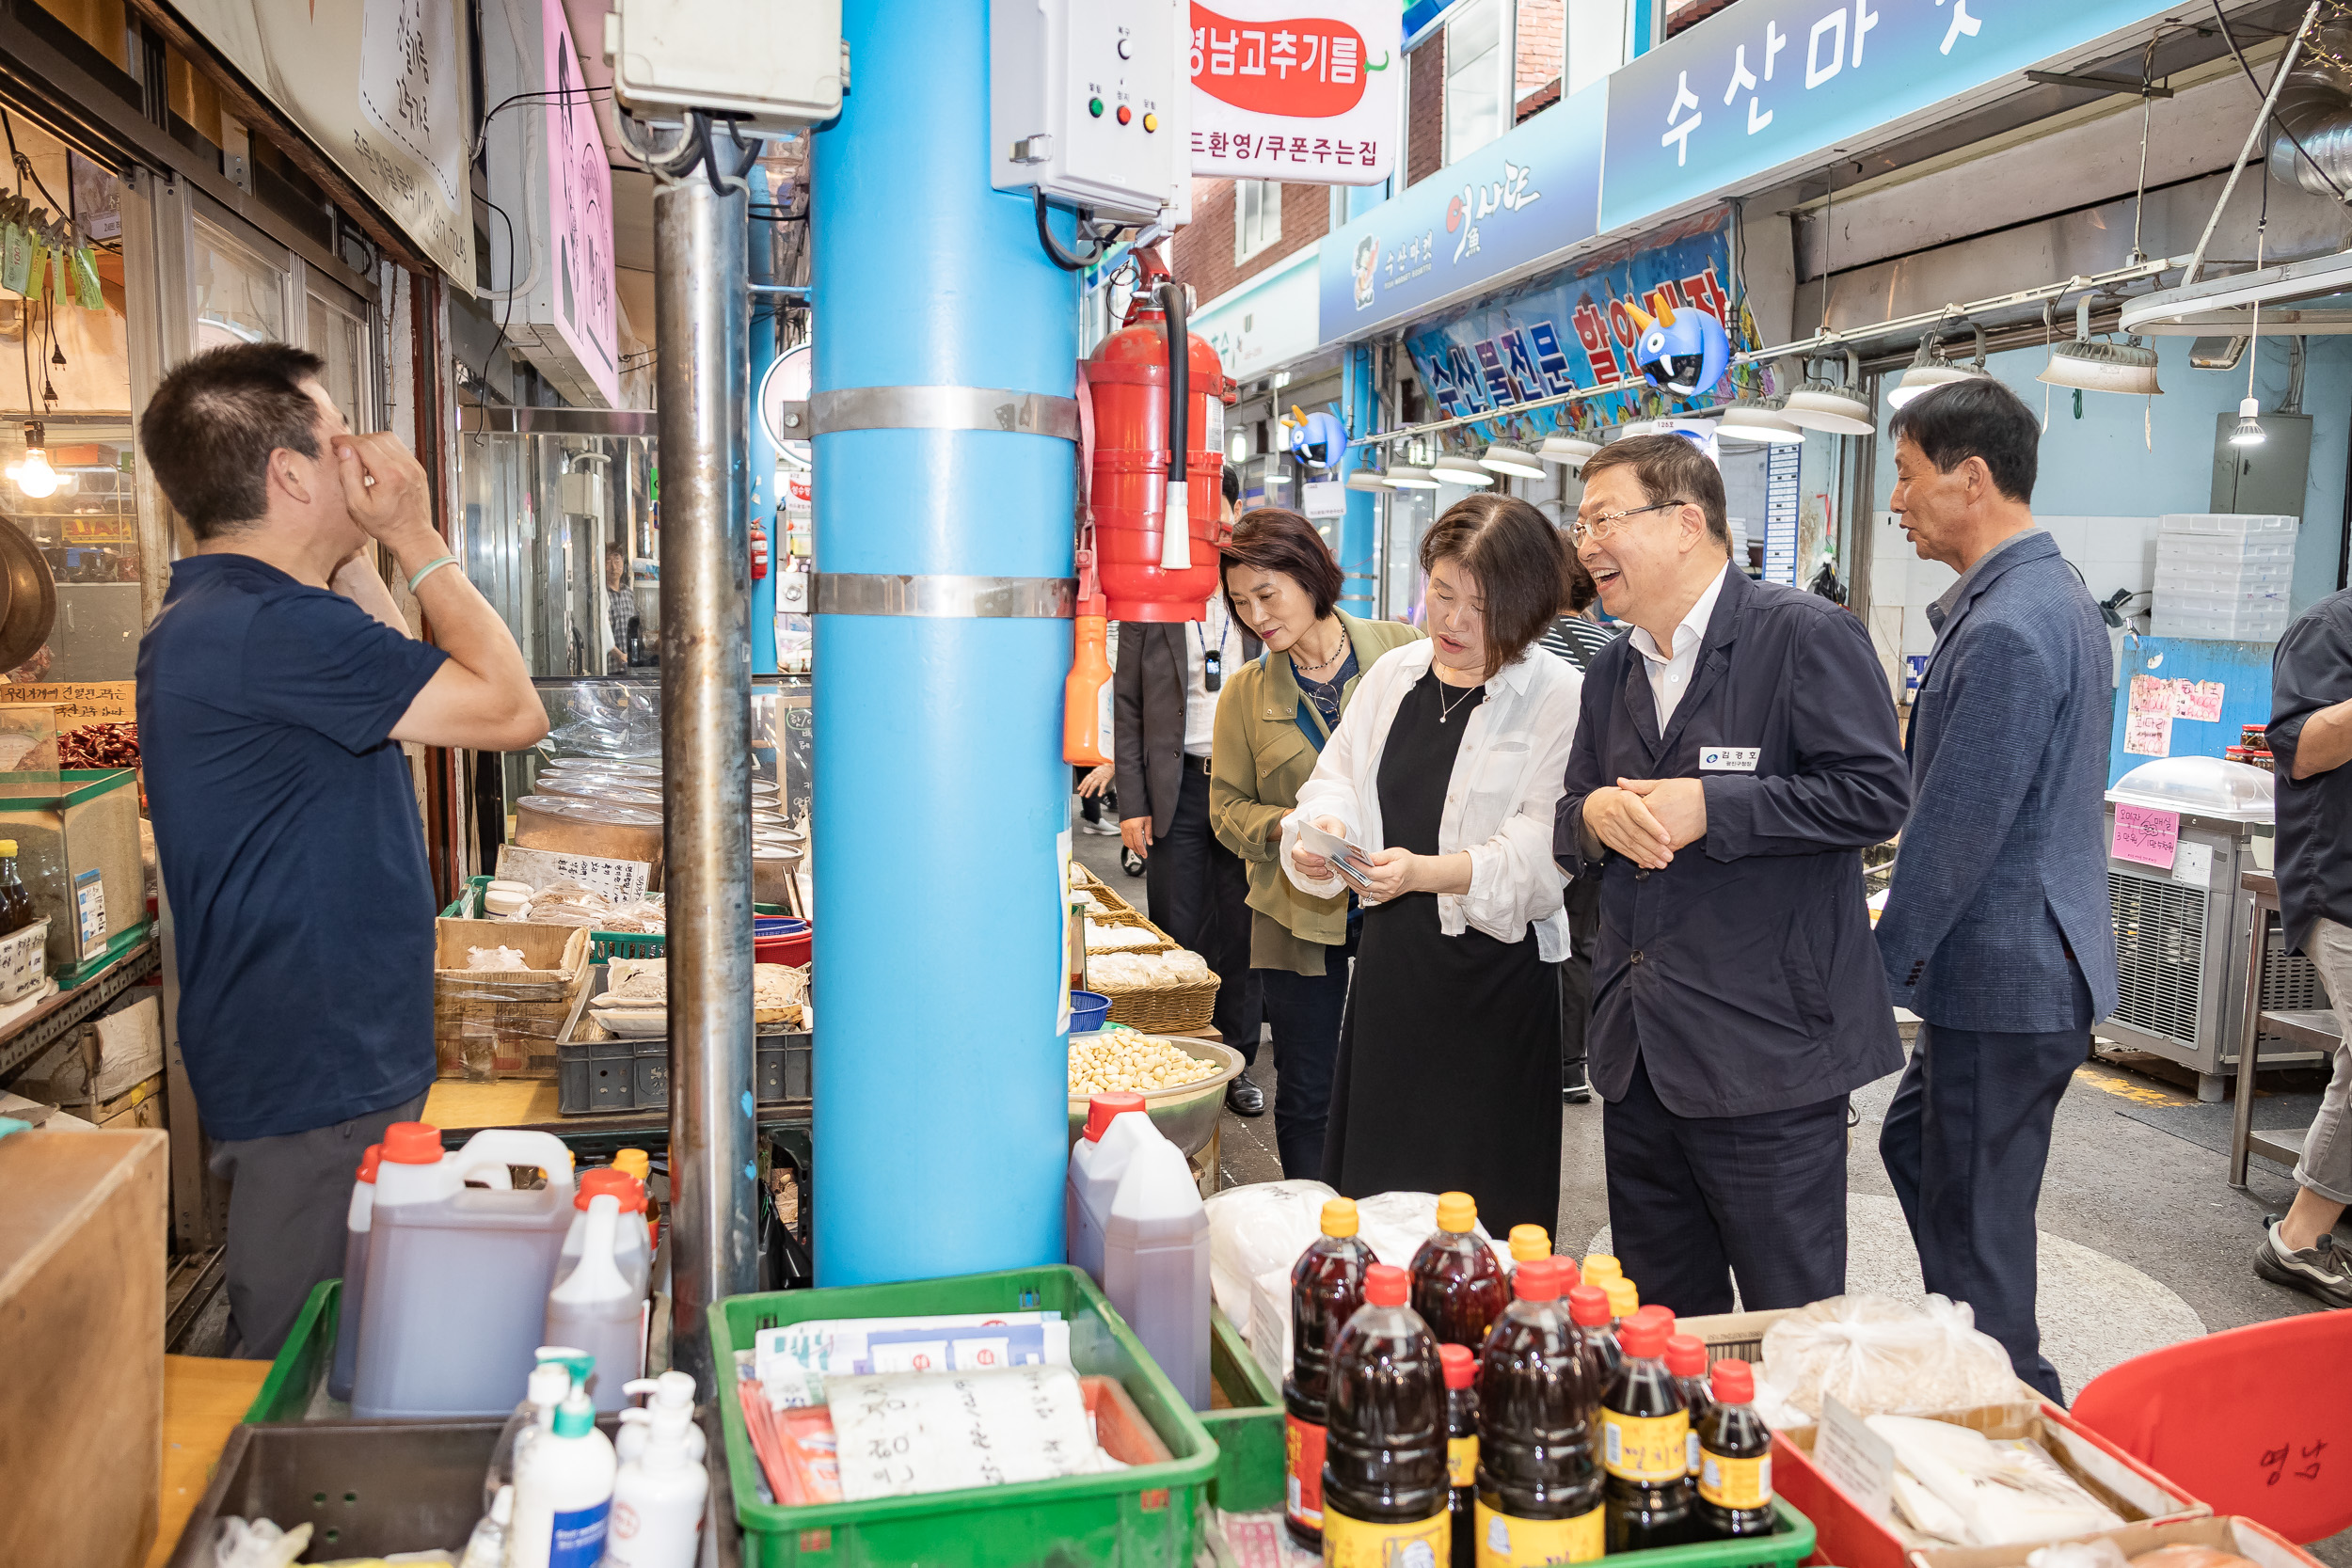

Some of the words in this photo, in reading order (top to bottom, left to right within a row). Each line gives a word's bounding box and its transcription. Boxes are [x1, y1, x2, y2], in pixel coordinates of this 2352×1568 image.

[1191, 27, 1358, 84] 영남고추기름
[1385, 229, 1433, 277] 수산마켓
[1430, 321, 1577, 416] 수산물전문
[1572, 268, 1729, 385] 할인장
[2121, 809, 2141, 820] 오미자
[2154, 816, 2171, 831] 매실
